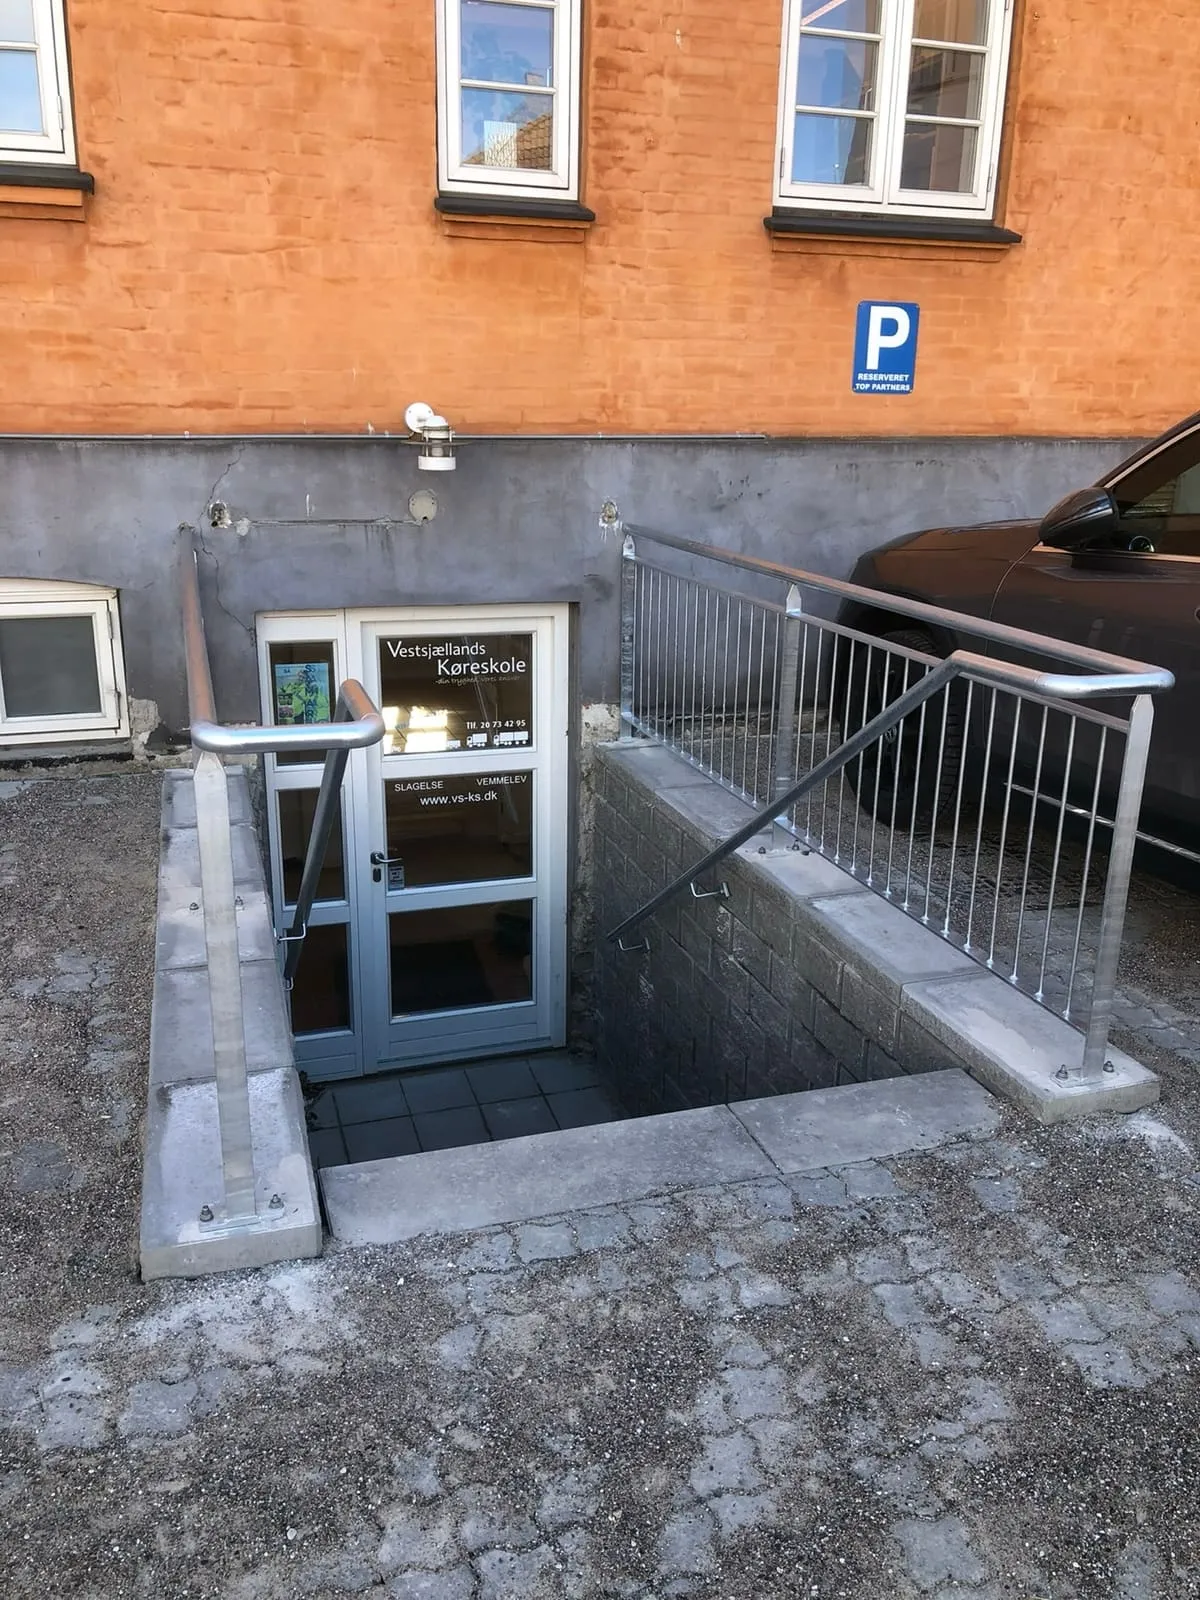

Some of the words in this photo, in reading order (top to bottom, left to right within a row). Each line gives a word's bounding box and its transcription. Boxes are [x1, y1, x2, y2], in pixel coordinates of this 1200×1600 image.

[866, 306, 910, 370] P
[858, 373, 910, 382] RESERVERET
[855, 383, 870, 391] TOP
[872, 383, 910, 391] PARTNERS
[386, 640, 486, 660] Vestsjællands
[437, 657, 526, 676] Køreskole
[466, 721, 478, 729] Tlf.
[480, 721, 490, 729] 20
[492, 720, 502, 728] 73
[515, 719, 526, 727] 95
[394, 781, 444, 792] SLAGELSE
[476, 775, 527, 786] VEMMELEV
[419, 790, 498, 806] www.vs-ks.dk
